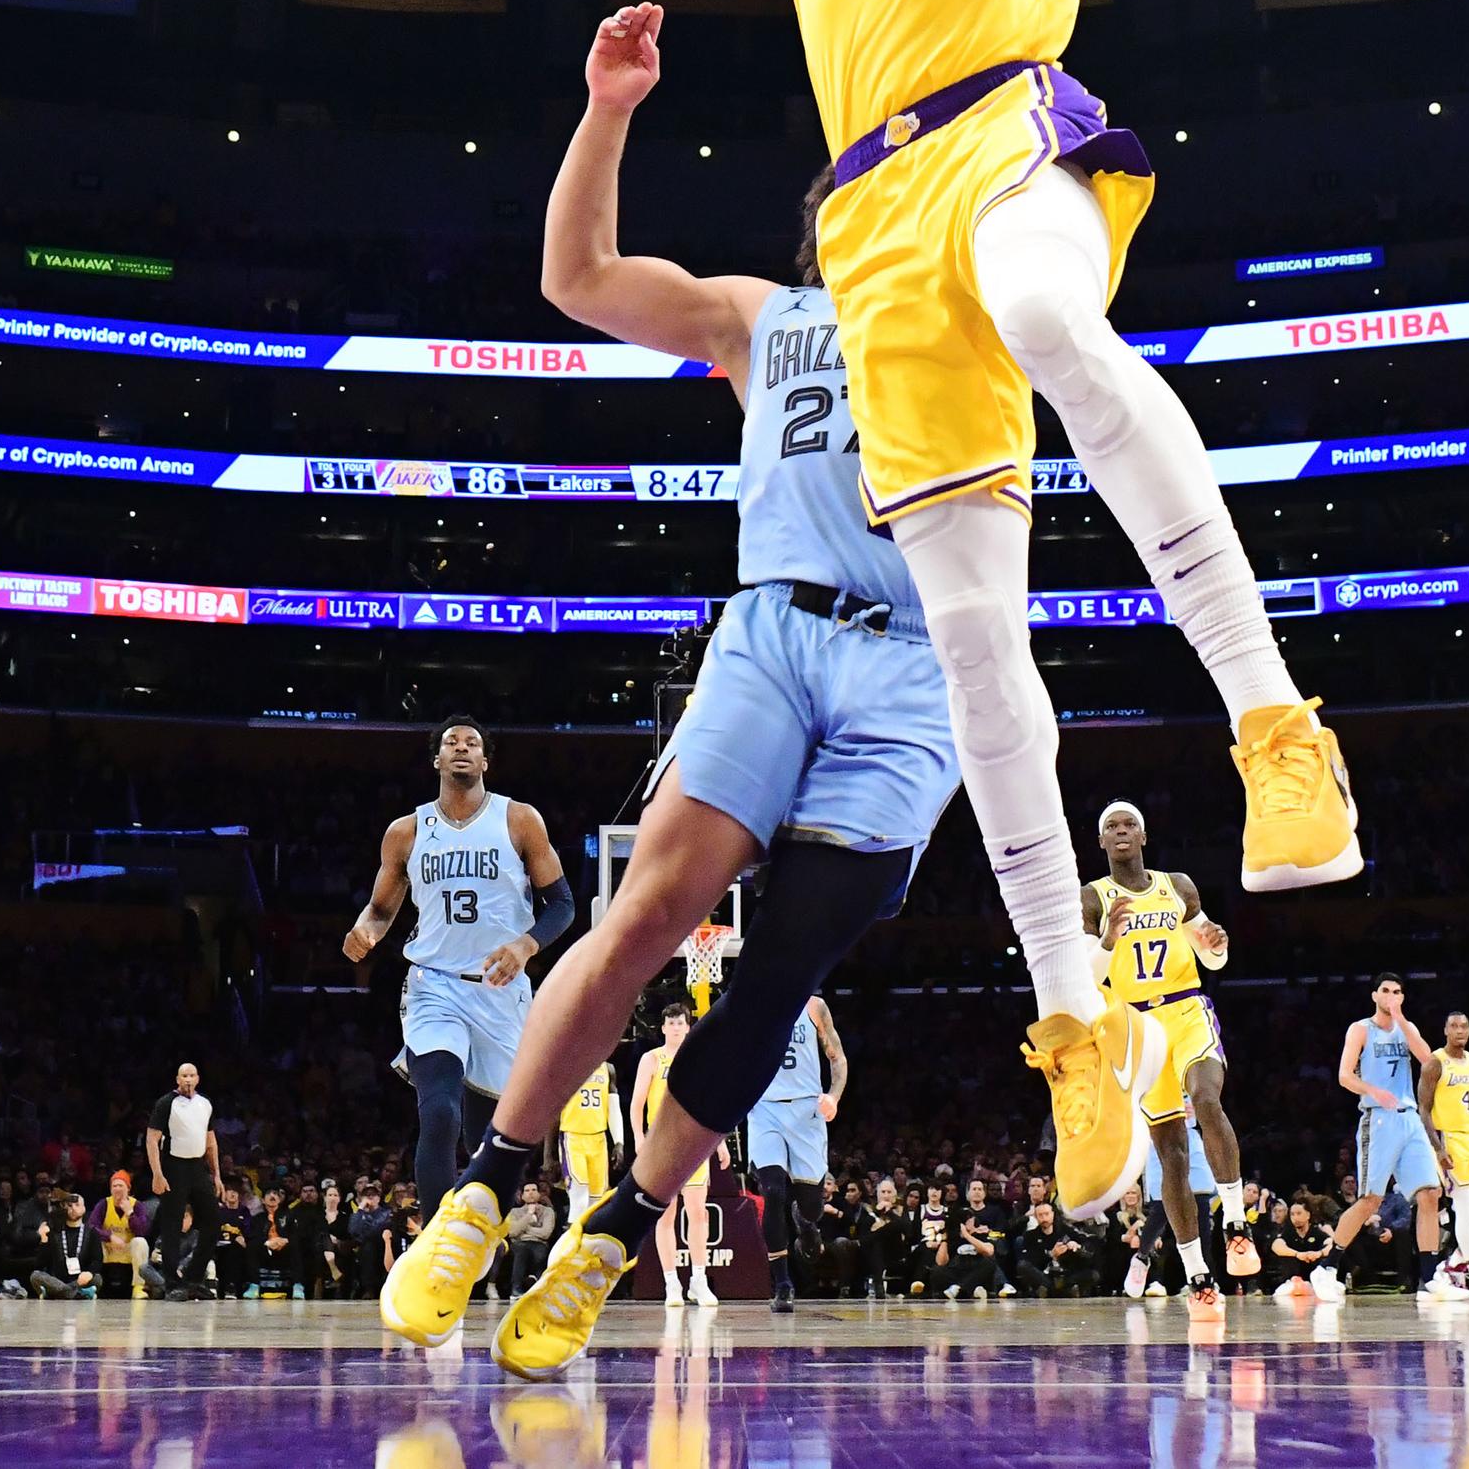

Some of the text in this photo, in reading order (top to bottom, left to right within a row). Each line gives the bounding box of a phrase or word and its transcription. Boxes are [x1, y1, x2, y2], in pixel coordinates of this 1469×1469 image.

[1247, 252, 1373, 275] AMERICAN EXPRESS
[1286, 312, 1449, 347] TOSHIBA
[428, 345, 586, 371] TOSHIBA
[766, 324, 848, 390] GRIZ
[10, 447, 28, 461] of
[33, 448, 136, 470] Crypto.com
[141, 457, 193, 474] Arena
[321, 472, 366, 490] 3 1
[467, 468, 507, 494] 86
[548, 474, 612, 493] Lakers
[648, 469, 725, 498] 8:47
[1036, 474, 1051, 490] 2
[45, 579, 82, 596] TASTES
[1362, 575, 1460, 600] crypto.com
[37, 592, 69, 609] TACOS
[100, 585, 241, 619] TOSHIBA
[252, 597, 396, 620] Michelob ULTRA
[1057, 597, 1156, 620] DELTA
[446, 602, 544, 625] DELTA
[563, 608, 698, 622] AMERICAN EXPRESS
[421, 848, 500, 885] GRIZZLIES
[441, 890, 478, 925] 13
[1121, 911, 1179, 936] AKERS
[1133, 939, 1168, 979] 17
[1387, 1059, 1399, 1078] 7
[580, 1089, 601, 1108] 35
